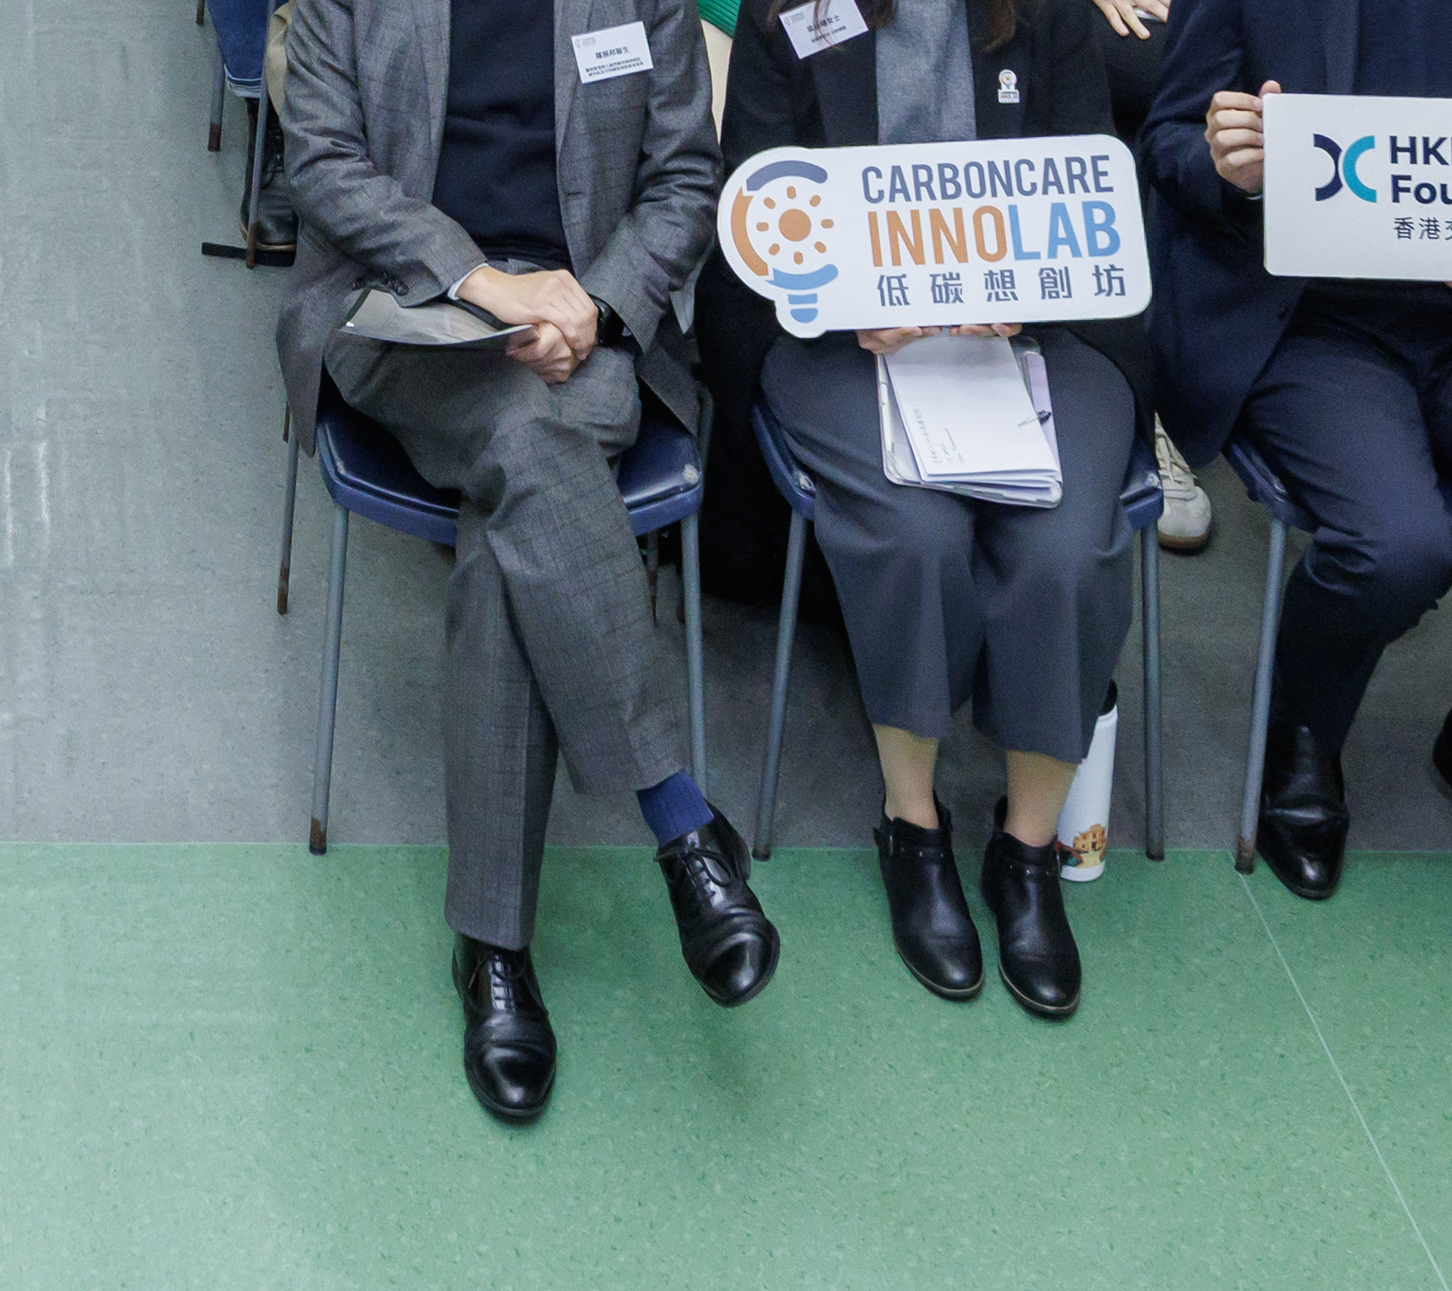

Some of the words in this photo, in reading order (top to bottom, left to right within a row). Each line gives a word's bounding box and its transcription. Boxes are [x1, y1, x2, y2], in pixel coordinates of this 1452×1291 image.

[861, 155, 1114, 204] CARBONCARE
[867, 200, 1121, 267] INNOLAB
[877, 264, 1127, 307] 低碳想創坊
